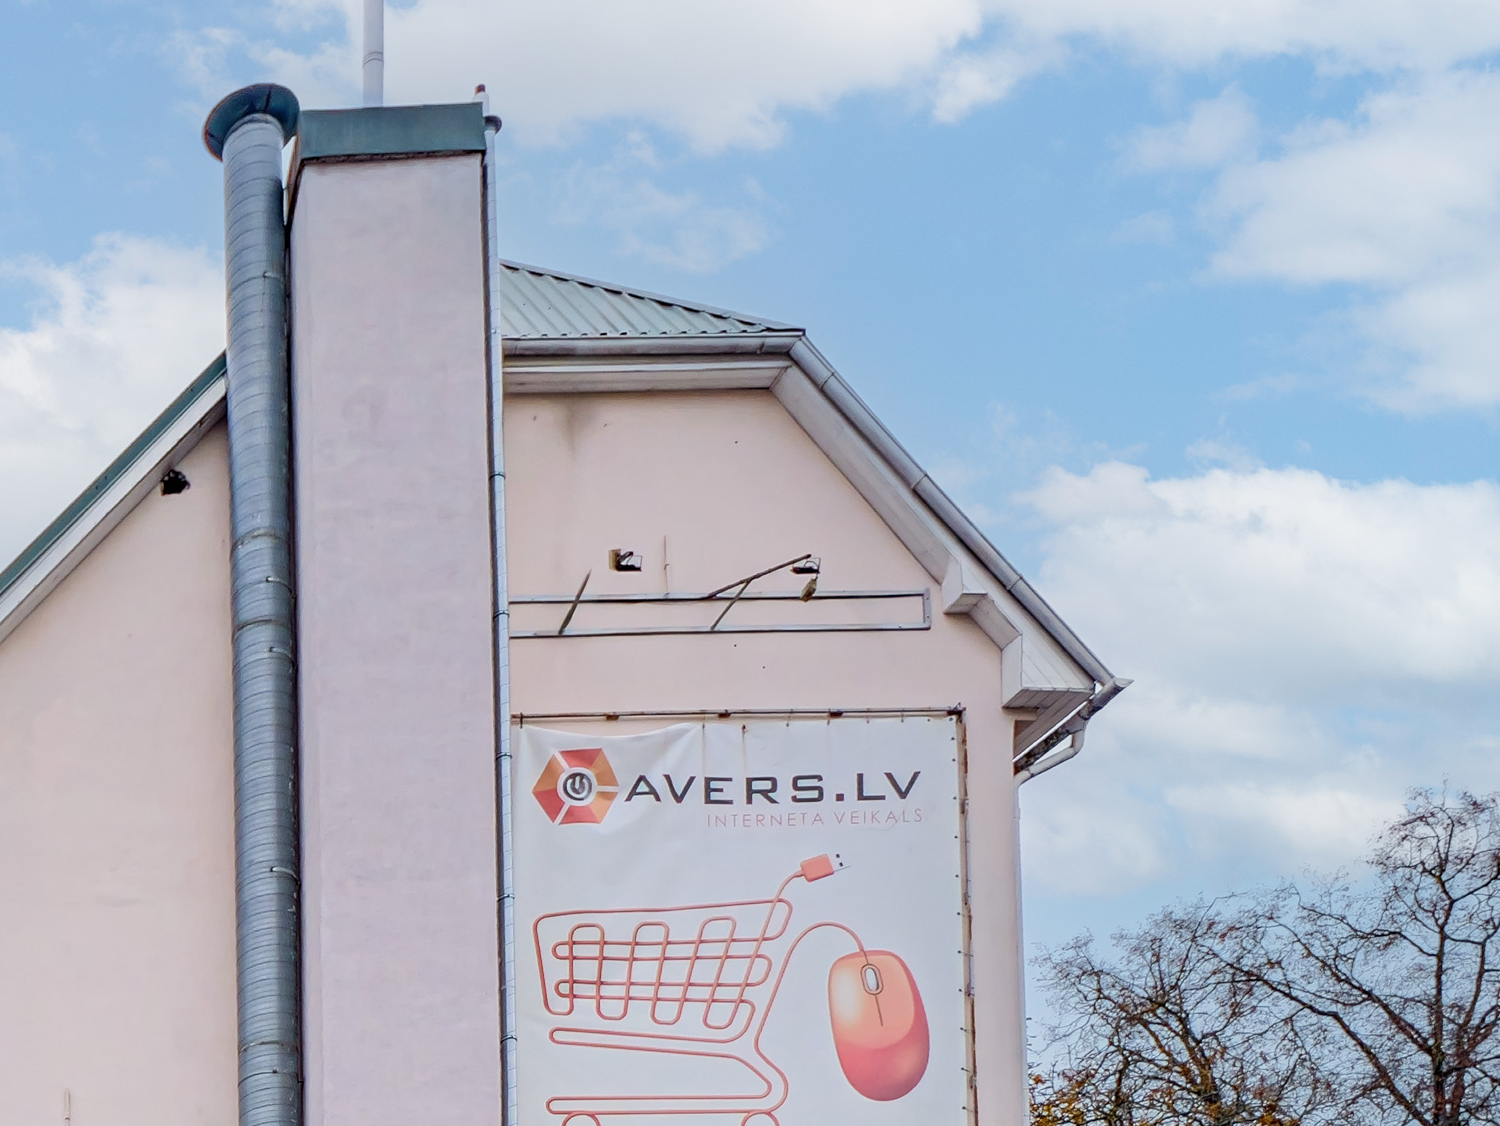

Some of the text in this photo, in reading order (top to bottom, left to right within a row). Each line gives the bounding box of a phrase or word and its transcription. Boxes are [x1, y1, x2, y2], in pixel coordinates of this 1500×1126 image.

[623, 771, 921, 805] AVERS.LV
[706, 807, 924, 828] INTERNETA VEIKALS
